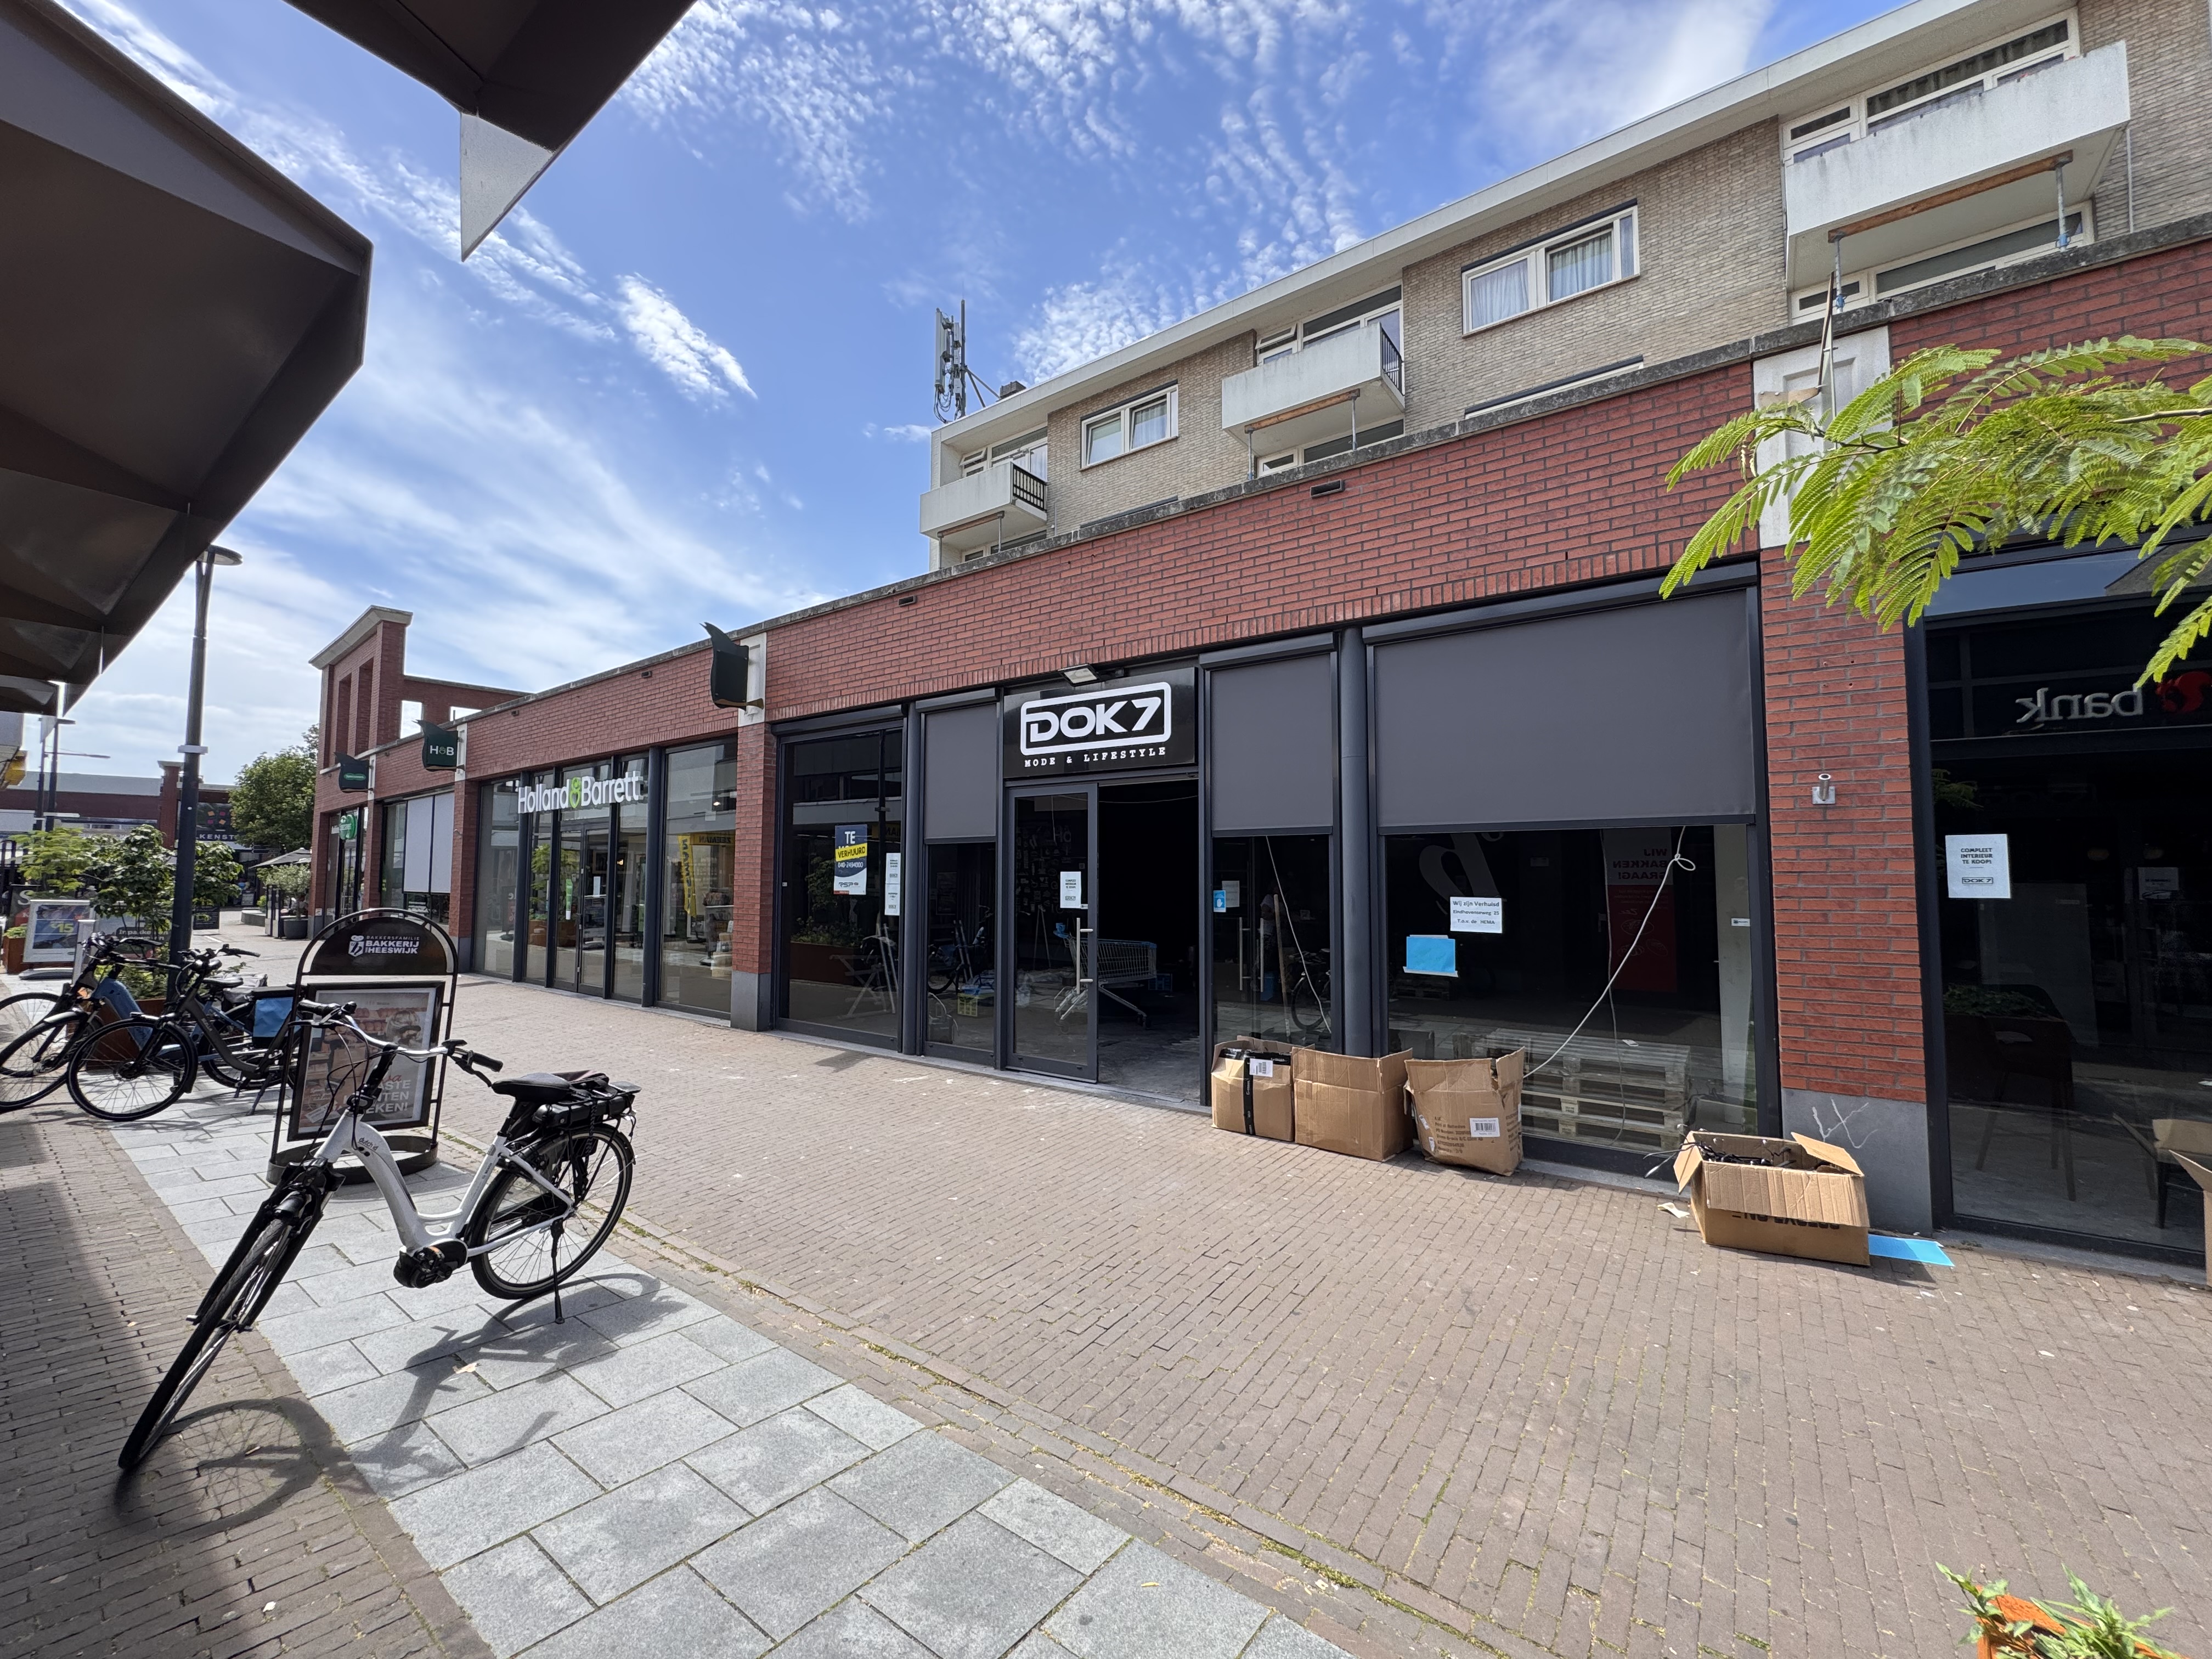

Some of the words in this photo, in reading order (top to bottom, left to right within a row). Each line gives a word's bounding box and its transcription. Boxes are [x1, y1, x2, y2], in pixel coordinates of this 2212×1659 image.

[1024, 757, 1056, 768] MODE
[1084, 747, 1166, 763] LIFESTYLE
[845, 831, 855, 844] TE
[838, 846, 866, 859] VERHUURD
[377, 1080, 411, 1090] ASTE
[366, 1102, 408, 1114] EKEN!
[359, 1137, 373, 1148] dutch
